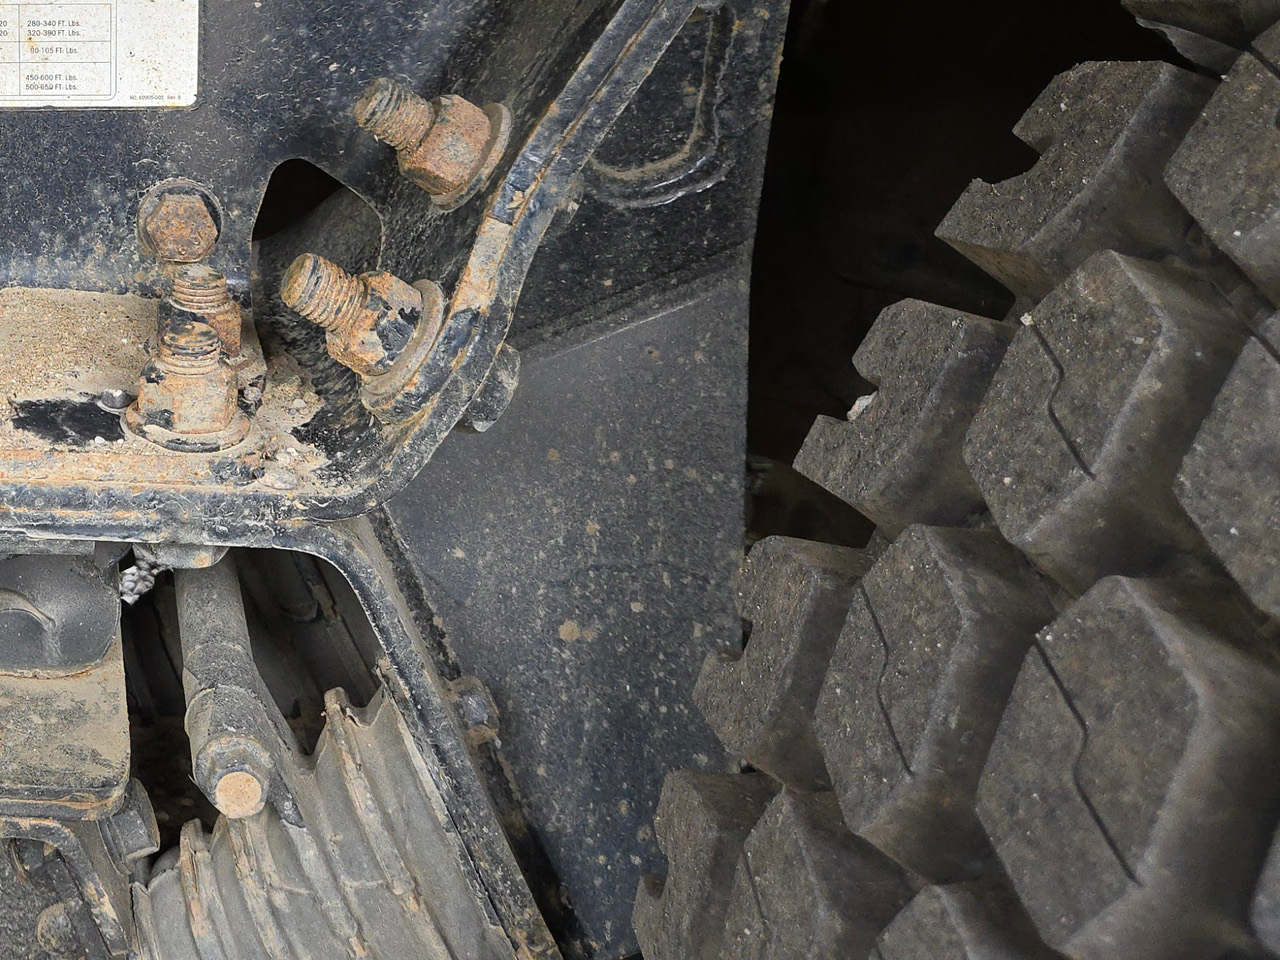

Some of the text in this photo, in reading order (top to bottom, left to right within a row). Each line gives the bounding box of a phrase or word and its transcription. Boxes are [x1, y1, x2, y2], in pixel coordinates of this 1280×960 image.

[27, 29, 81, 37] 320-390 FT. Lbs.
